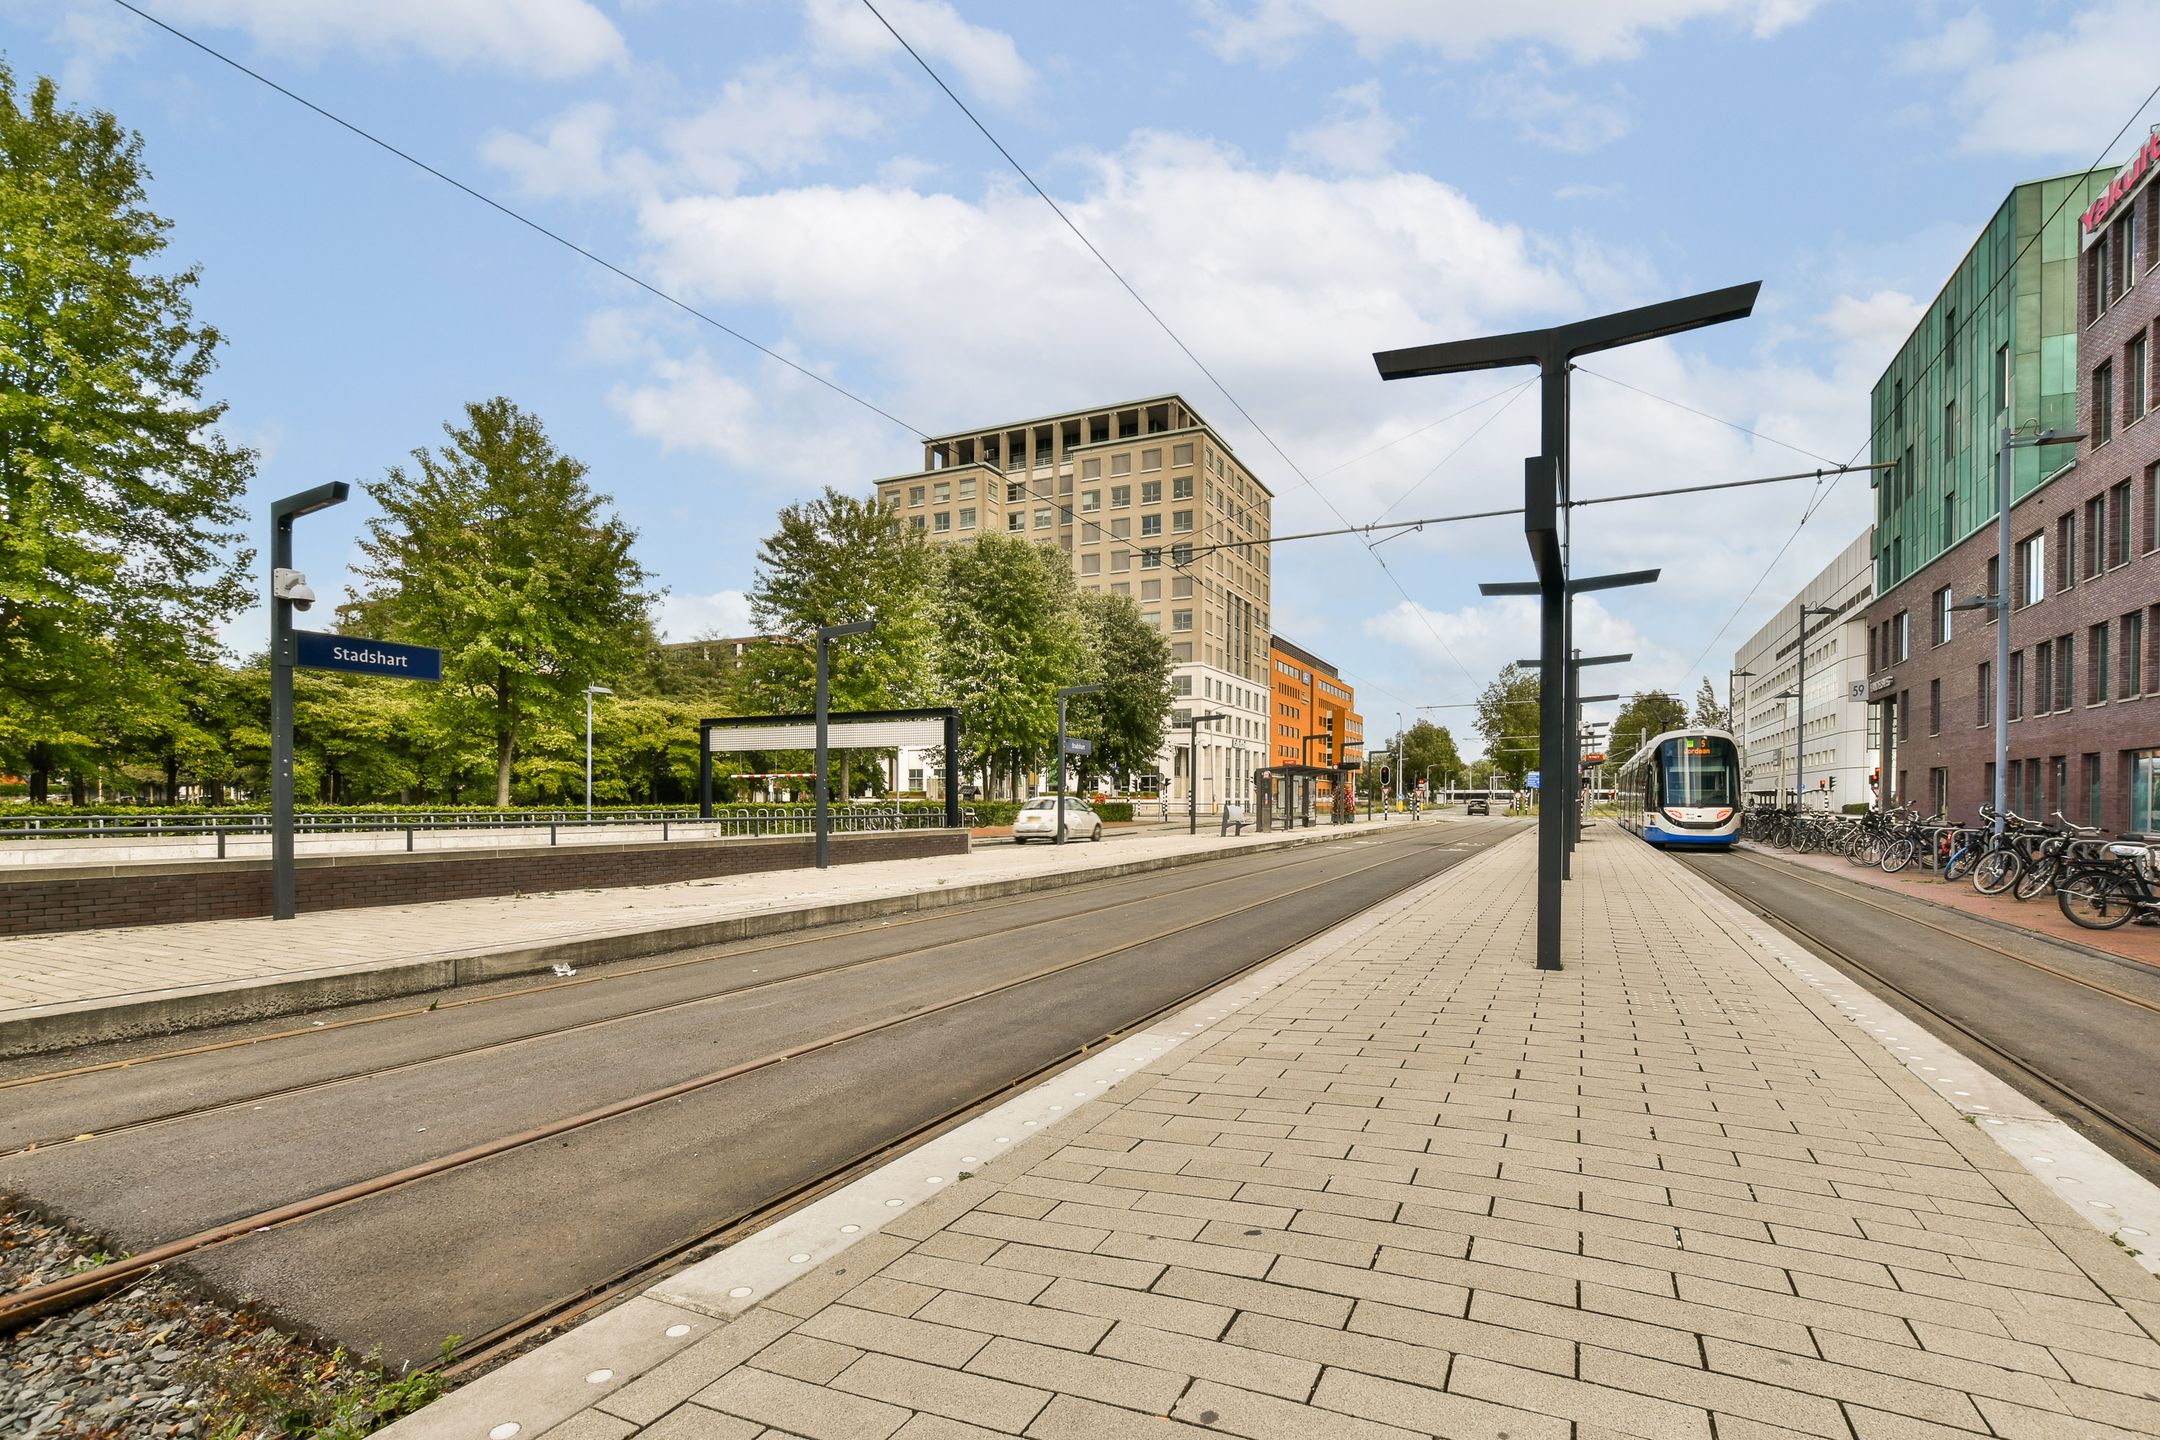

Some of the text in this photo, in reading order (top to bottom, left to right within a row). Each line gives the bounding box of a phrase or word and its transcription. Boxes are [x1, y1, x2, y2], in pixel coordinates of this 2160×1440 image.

[333, 646, 408, 667] Stadshart
[1852, 684, 1865, 697] 59
[1700, 739, 1706, 747] 5
